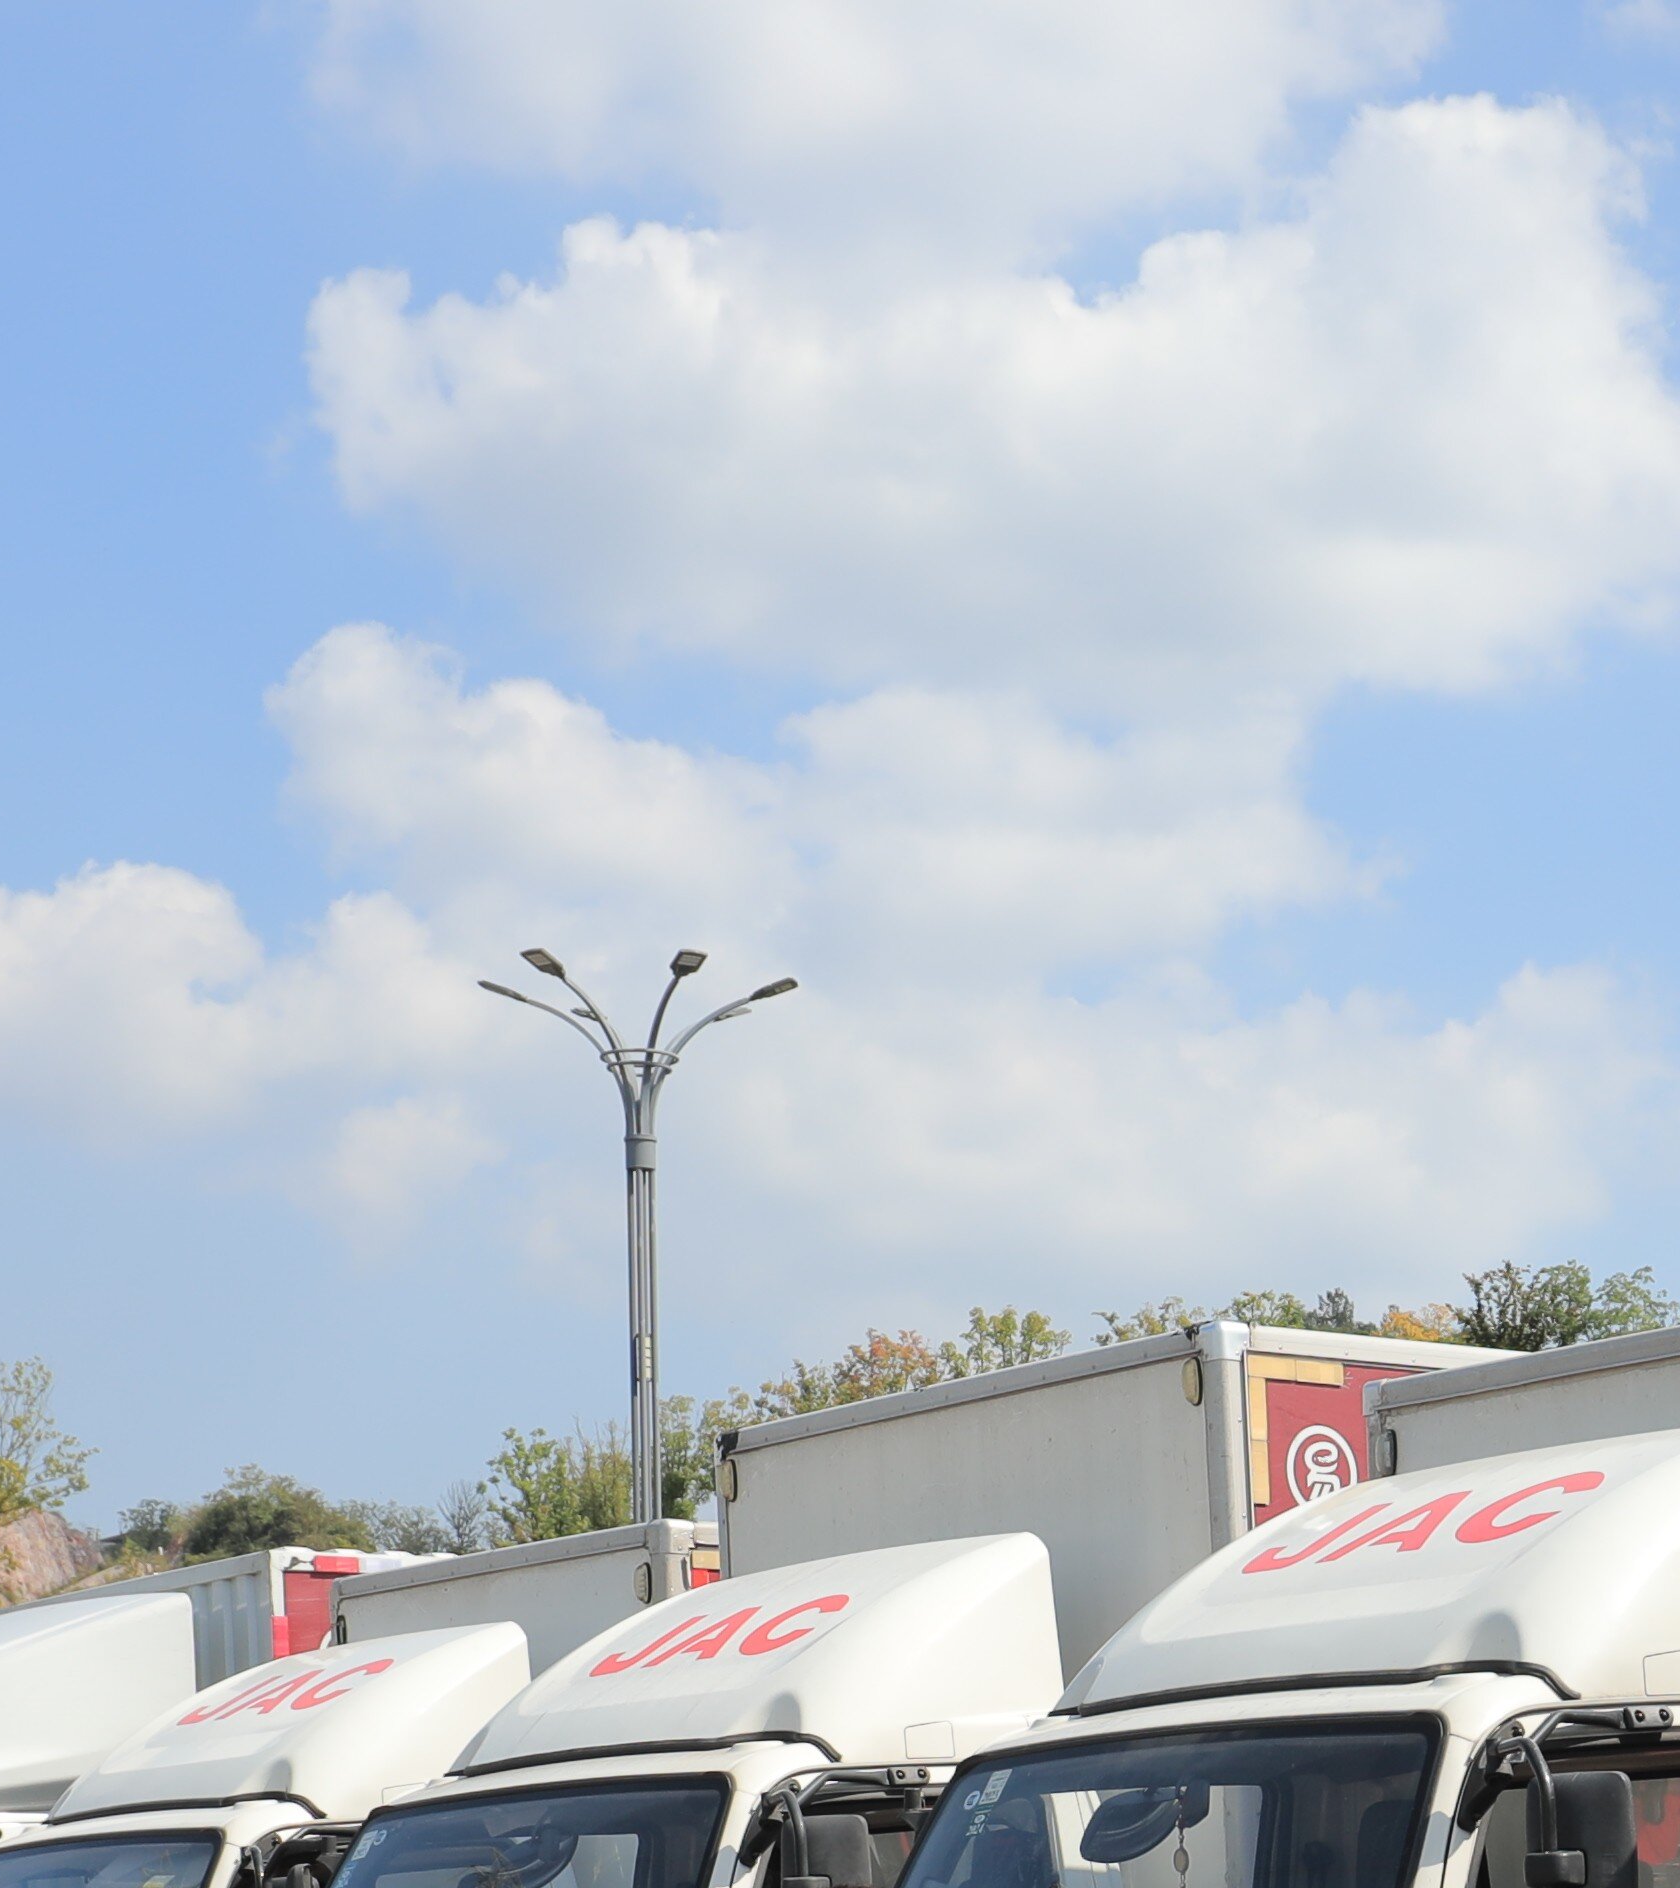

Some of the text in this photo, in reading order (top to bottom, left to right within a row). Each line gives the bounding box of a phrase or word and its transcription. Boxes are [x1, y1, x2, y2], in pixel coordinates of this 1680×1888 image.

[1241, 1471, 1605, 1575] JAC
[589, 1594, 849, 1677] JAC
[177, 1658, 394, 1726] JAC
